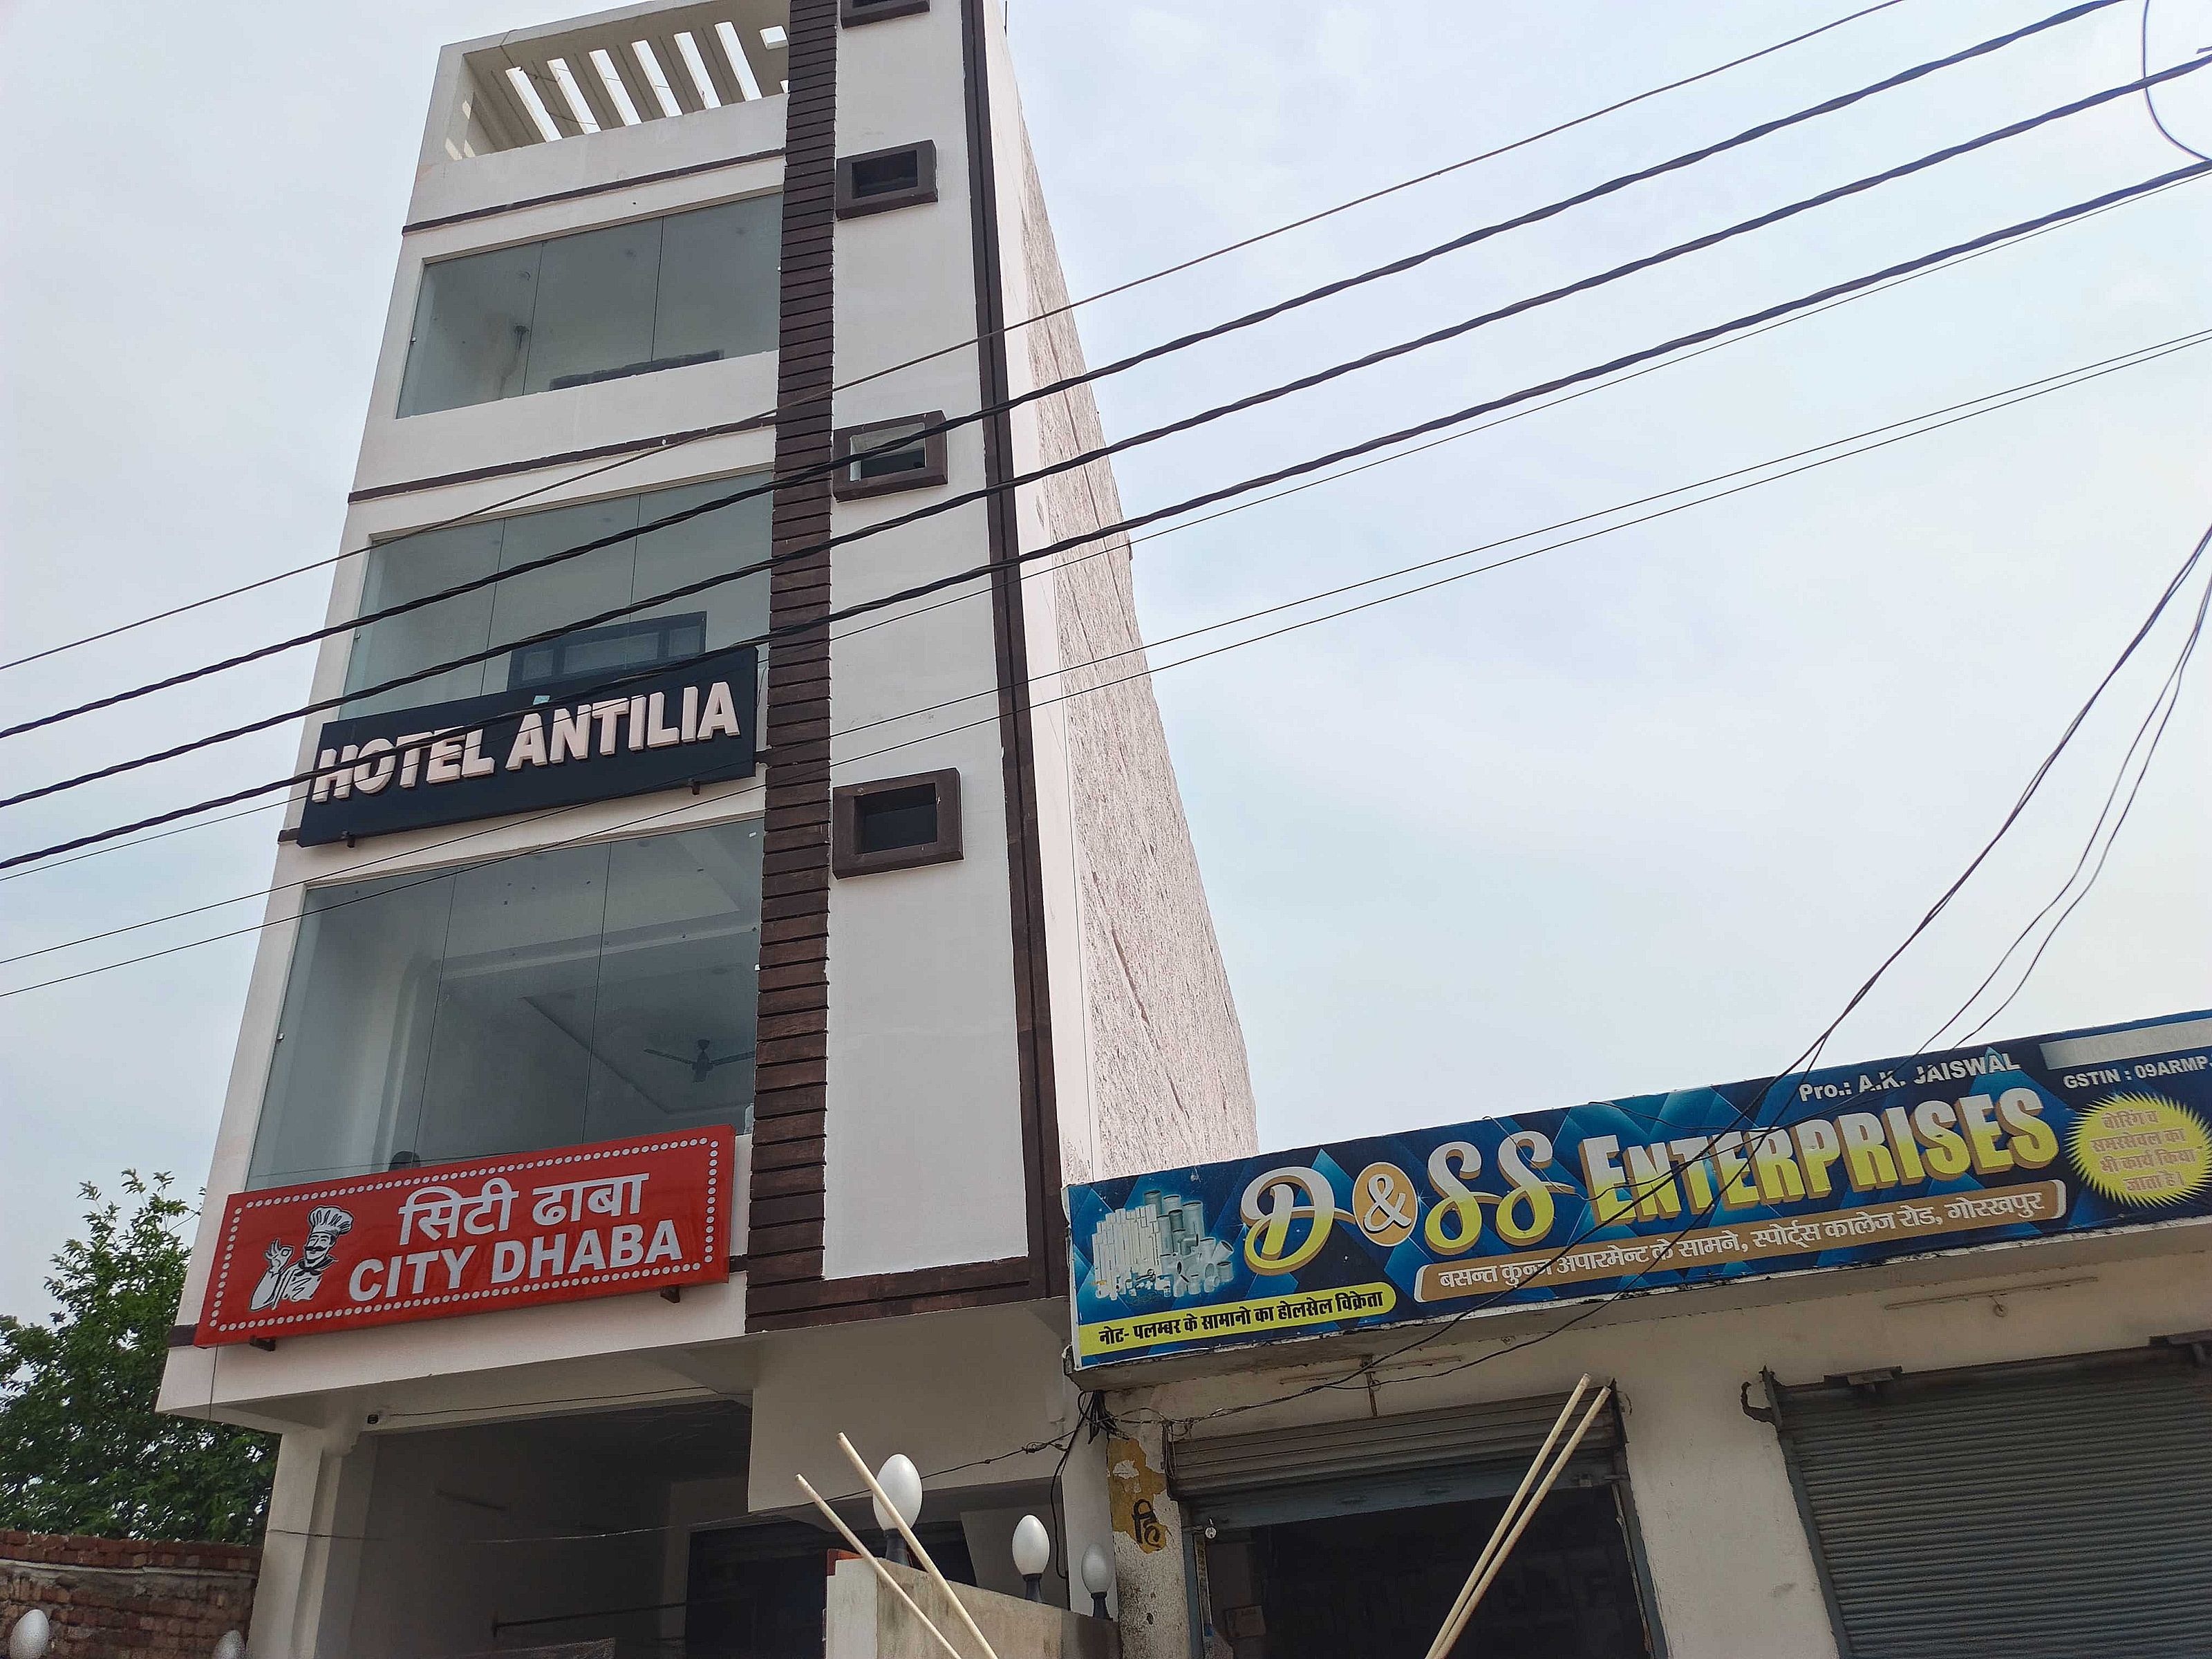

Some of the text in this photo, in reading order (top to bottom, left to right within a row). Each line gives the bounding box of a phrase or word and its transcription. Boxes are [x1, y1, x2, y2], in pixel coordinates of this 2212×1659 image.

[311, 680, 742, 803] HOTEL ANTILIA
[1799, 1052, 2022, 1103] Pro.: A.K. JAISWAL
[2063, 1068, 2121, 1089] GSTIN
[2133, 1053, 2212, 1080] 09ARMP
[397, 1172, 650, 1246] सिटी ढाबा
[1240, 1165, 1356, 1276] D
[1425, 1130, 1576, 1255] SS
[1579, 1087, 2059, 1227] ENTERPRISES
[348, 1219, 684, 1303] CITY DHABA
[1438, 1265, 1499, 1288] बसन्त
[1650, 1239, 1674, 1262] के
[1676, 1229, 1749, 1257] सामने,
[1822, 1211, 1897, 1238] कालेज
[1944, 1192, 2044, 1219] गोरखपुर
[1132, 1318, 1181, 1340] पलम्बर
[1183, 1313, 1198, 1332] के
[1200, 1306, 1251, 1331] सामानो
[1253, 1306, 1275, 1323] का
[1276, 1297, 1333, 1320] होलसेल
[1335, 1291, 1384, 1312] विक्रेता
